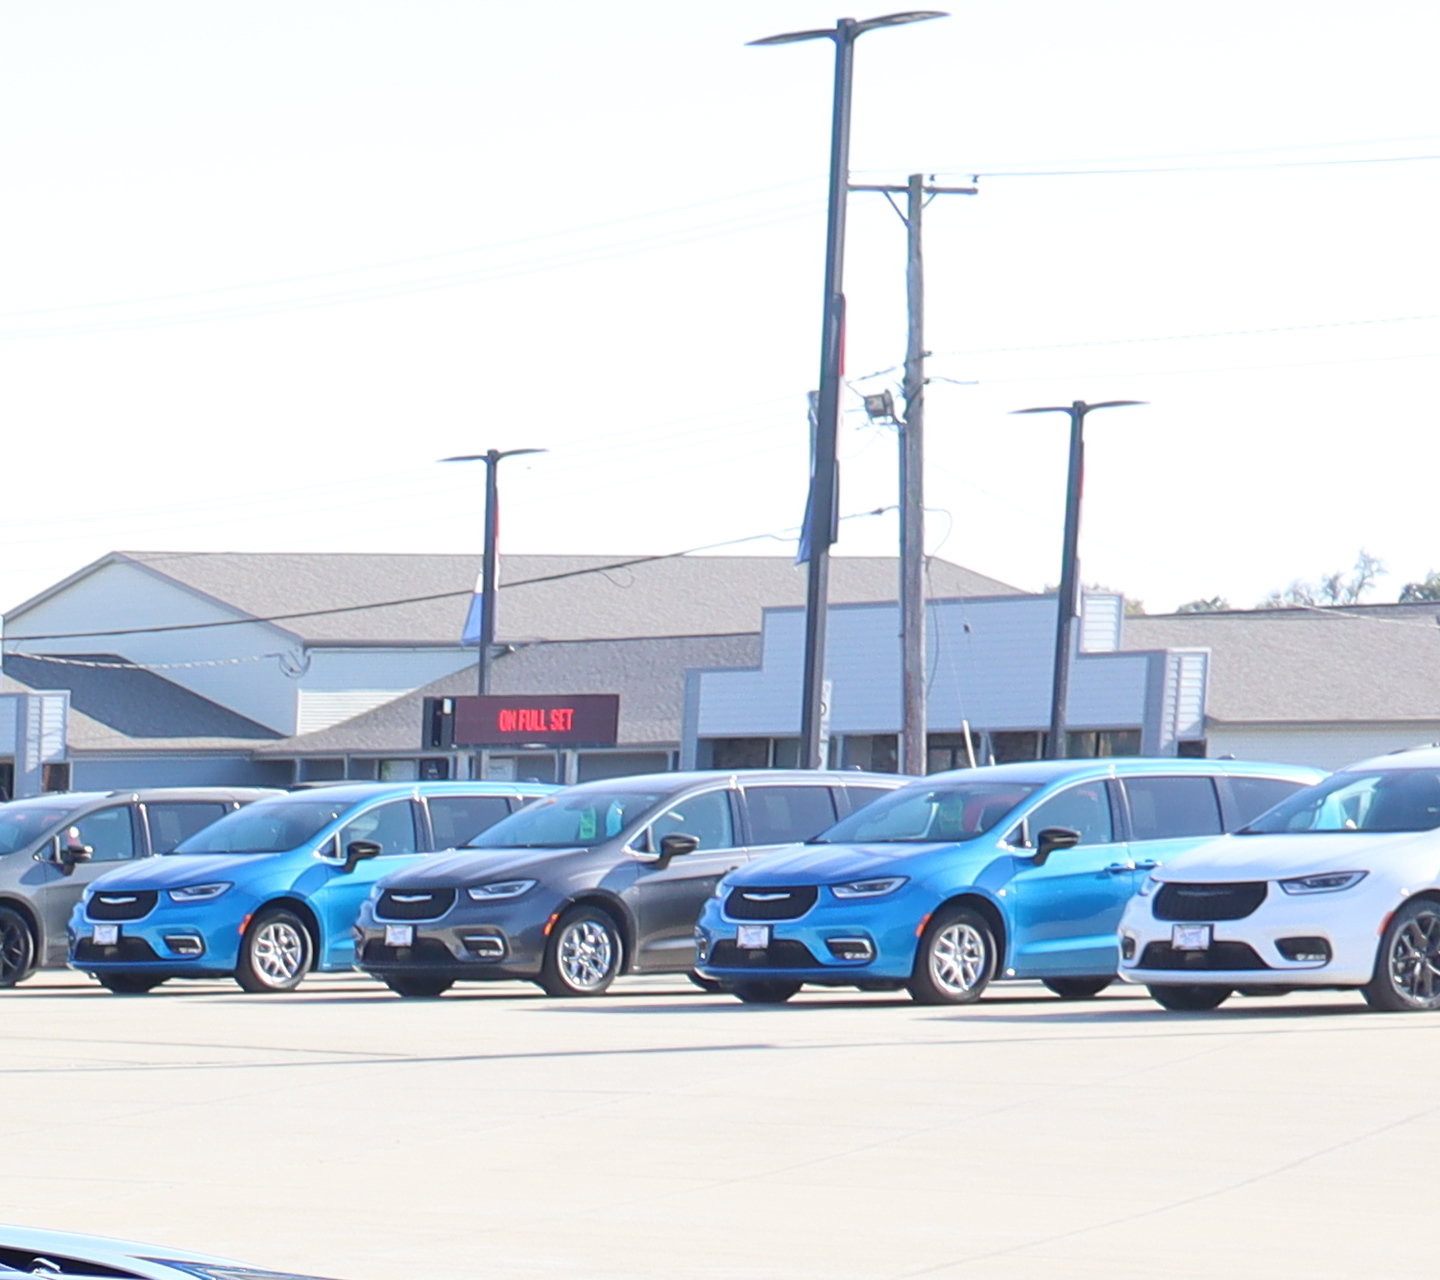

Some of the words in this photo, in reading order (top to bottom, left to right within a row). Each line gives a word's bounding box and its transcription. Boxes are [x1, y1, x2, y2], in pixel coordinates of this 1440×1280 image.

[498, 709, 516, 732] ON
[518, 709, 548, 732] FULL
[549, 708, 574, 731] SET
